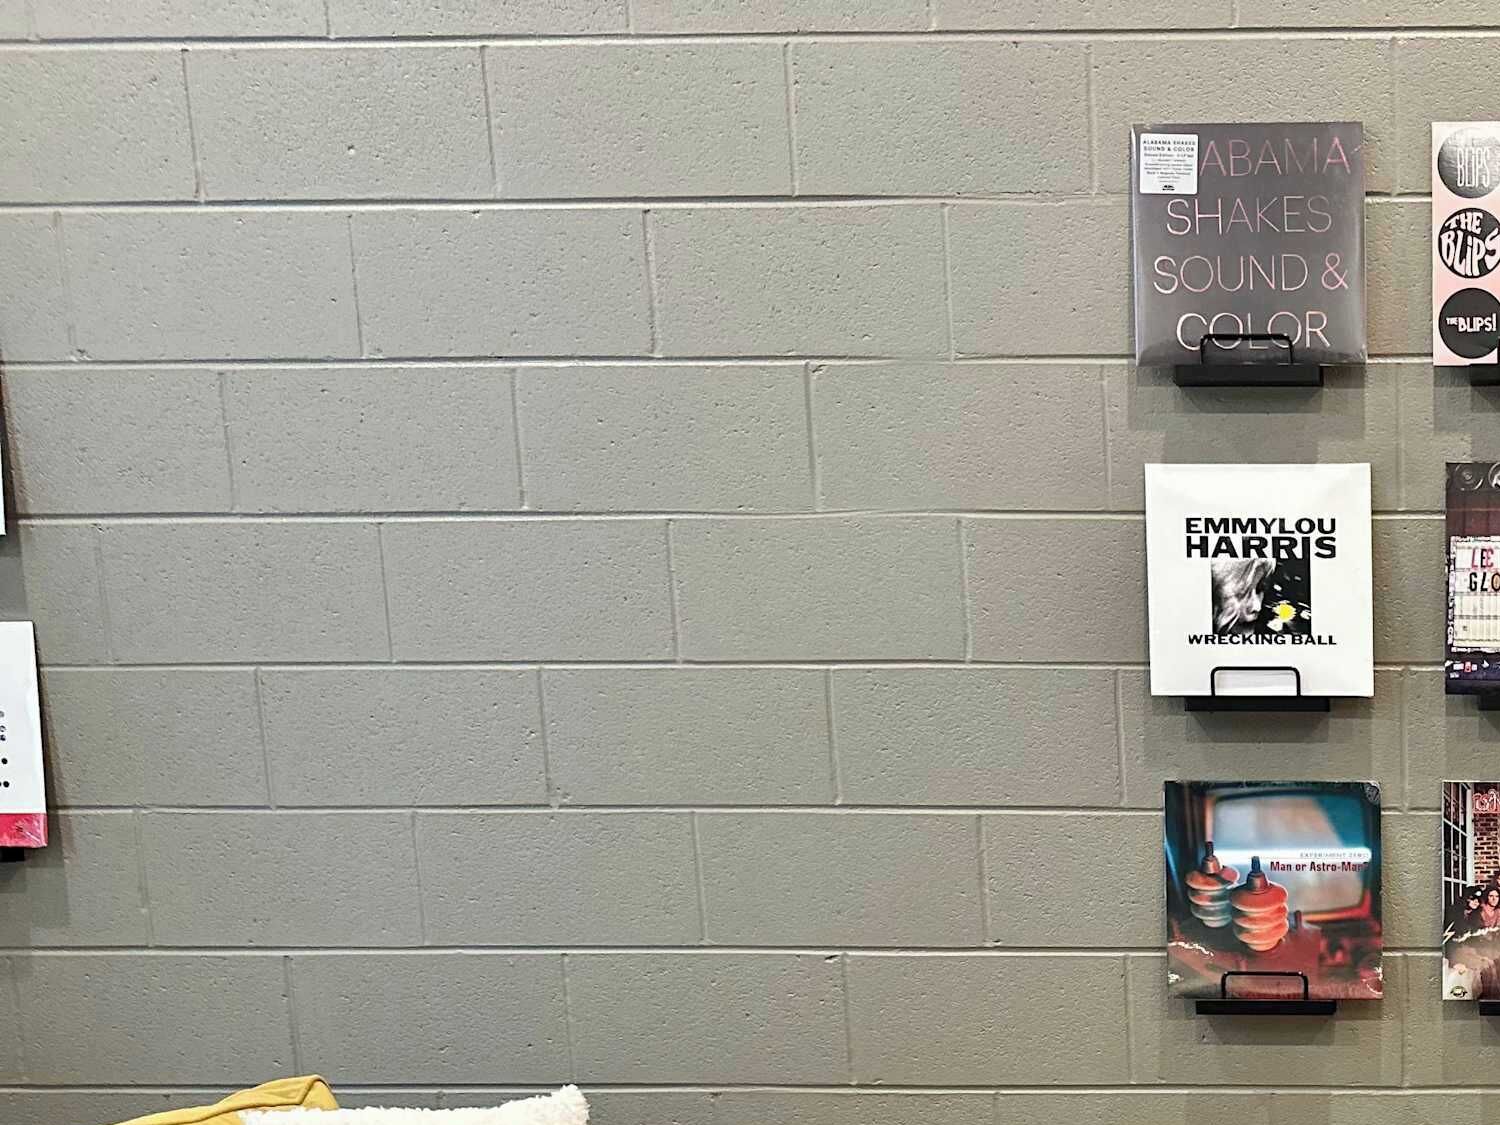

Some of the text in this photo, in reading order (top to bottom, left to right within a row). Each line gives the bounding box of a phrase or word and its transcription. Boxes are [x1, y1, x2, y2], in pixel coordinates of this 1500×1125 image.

[1199, 137, 1351, 177] ABAMA
[1166, 195, 1333, 236] SHAKES
[1444, 211, 1484, 234] THE
[1153, 252, 1350, 294] SOUND &
[1176, 310, 1331, 351] COLOR
[1446, 312, 1497, 333] THE BLIPS!
[1185, 517, 1337, 535] EMMYLOU
[1186, 535, 1337, 559] HARRIS
[1471, 548, 1494, 568] LEE
[1188, 633, 1337, 646] WRECKING BALL
[1270, 862, 1292, 872] Man
[1295, 864, 1307, 872] or
